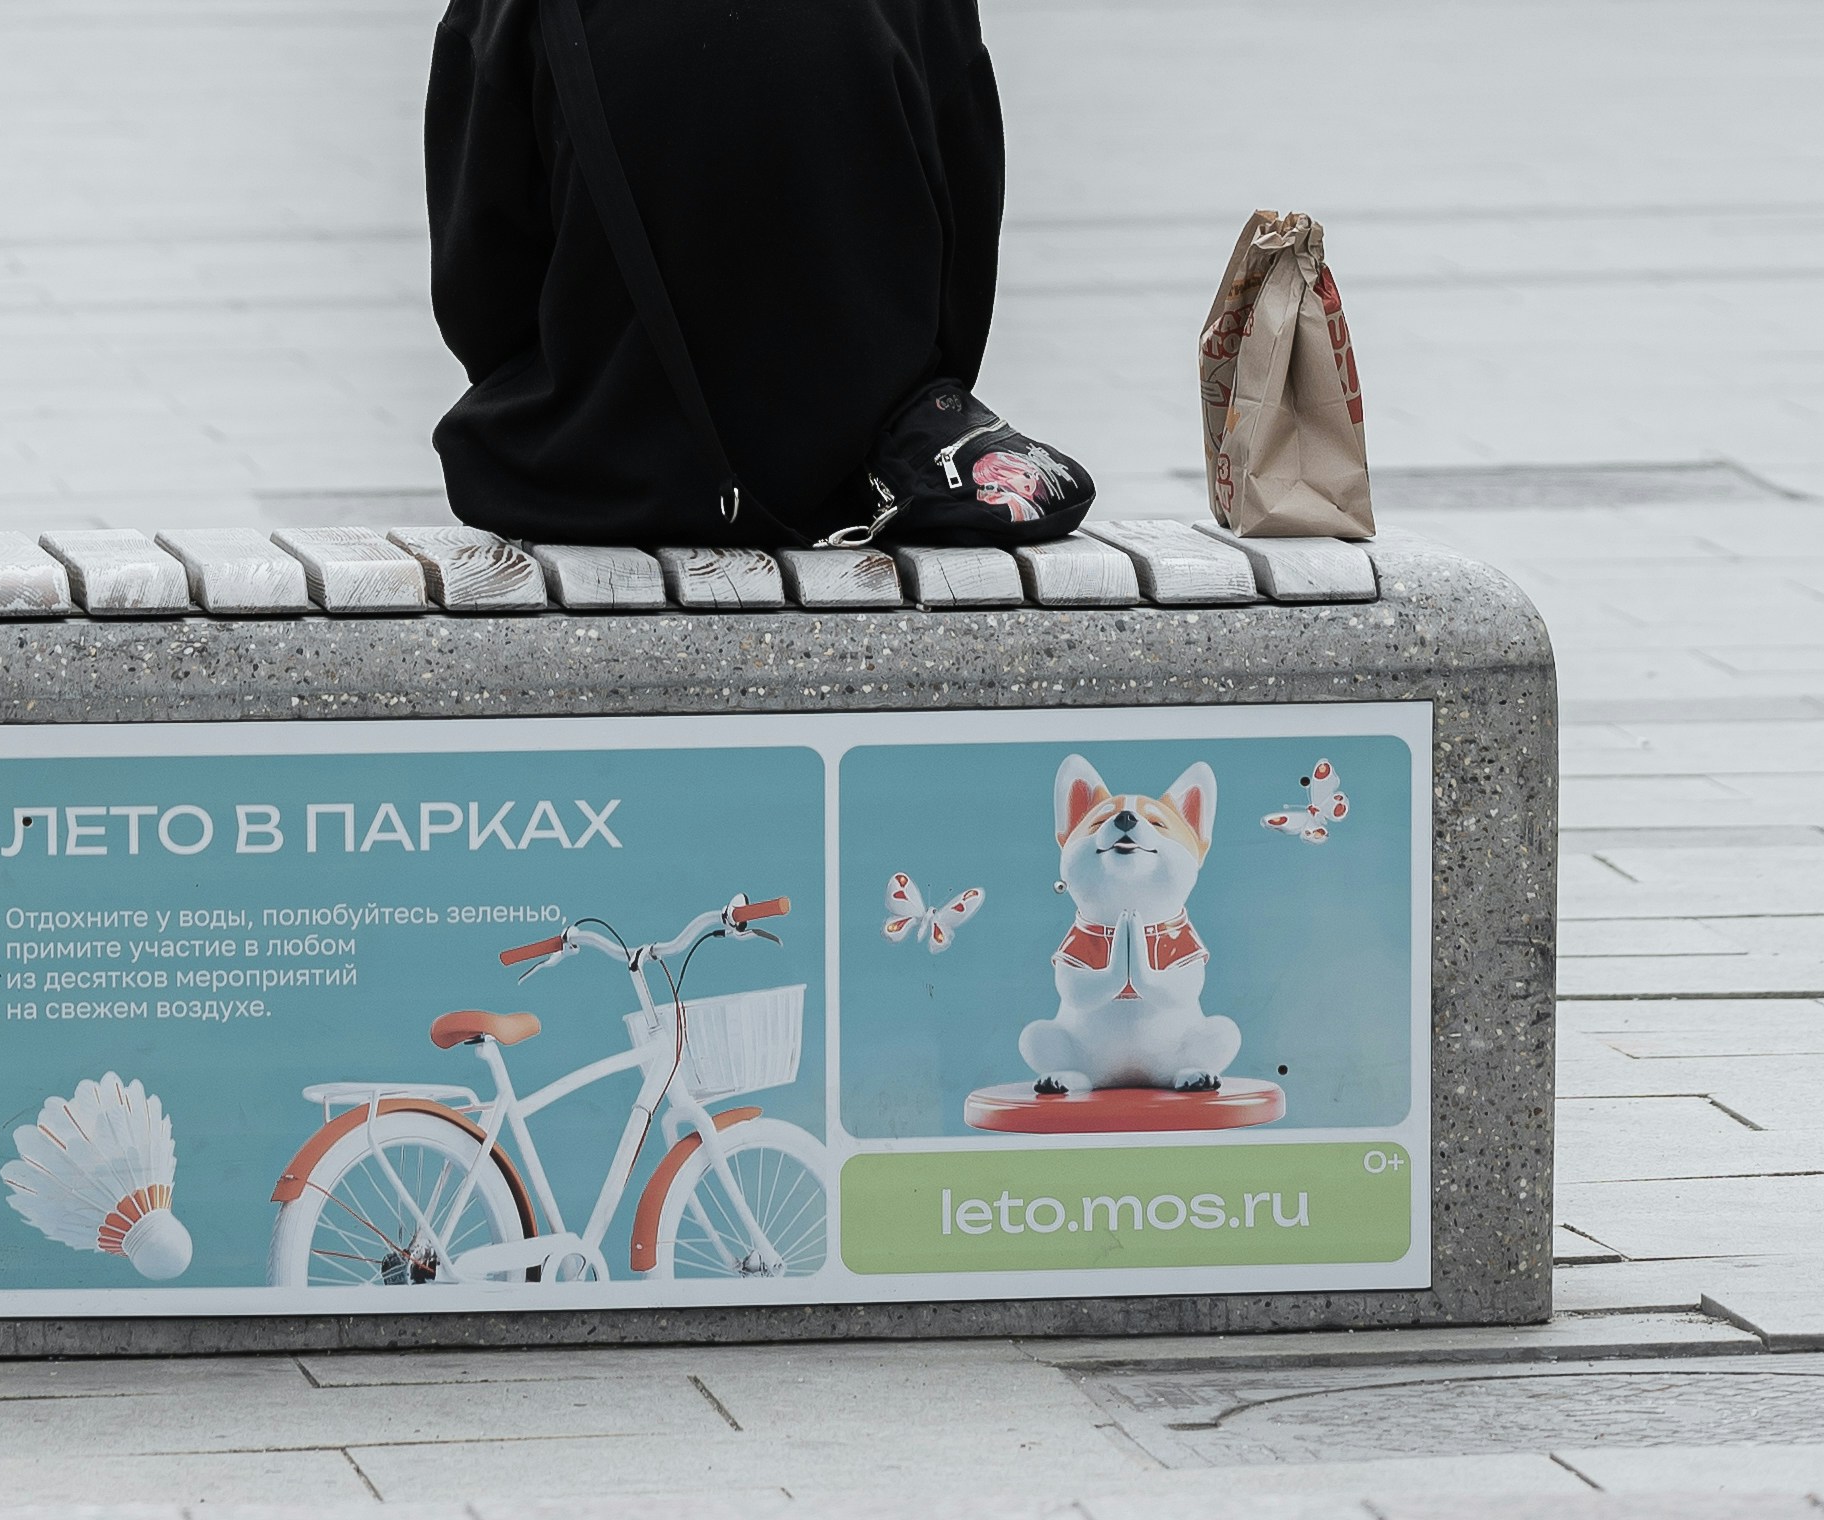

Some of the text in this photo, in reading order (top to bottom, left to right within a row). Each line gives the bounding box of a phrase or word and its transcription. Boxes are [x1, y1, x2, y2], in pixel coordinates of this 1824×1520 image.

[1, 798, 623, 857] ЛЕТО В ПАРКАХ
[5, 903, 569, 932] Отдохните у воды, полюбуйтесь зеленью,
[6, 934, 356, 962] примите участие в любом
[6, 963, 357, 992] из десятков мероприятий
[6, 1000, 272, 1025] на свежем воздухе.
[942, 1188, 1311, 1235] leto.mos.ru
